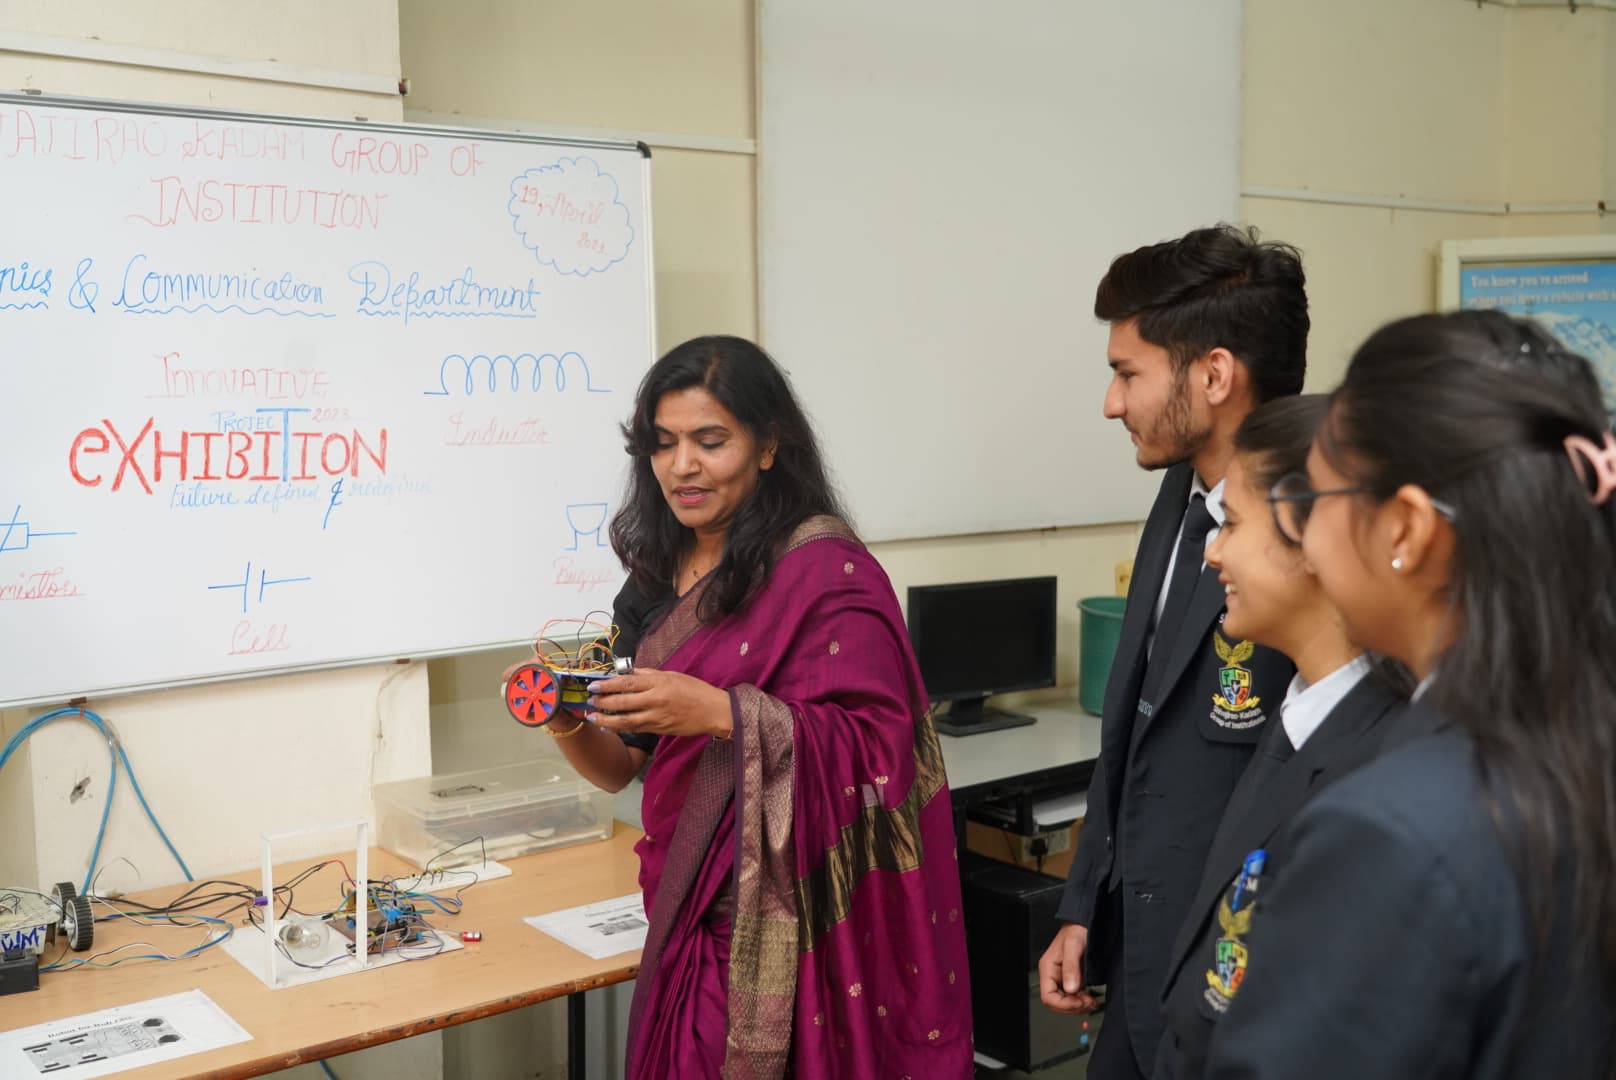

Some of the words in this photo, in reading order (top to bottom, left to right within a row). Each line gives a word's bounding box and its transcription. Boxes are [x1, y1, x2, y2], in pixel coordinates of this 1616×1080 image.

[182, 120, 305, 163] KADAM
[331, 132, 429, 175] GROUP
[449, 143, 485, 176] OF
[128, 175, 388, 229] INSTITUTION
[68, 257, 99, 314] &
[112, 253, 324, 307] Communication
[169, 481, 239, 510] Future
